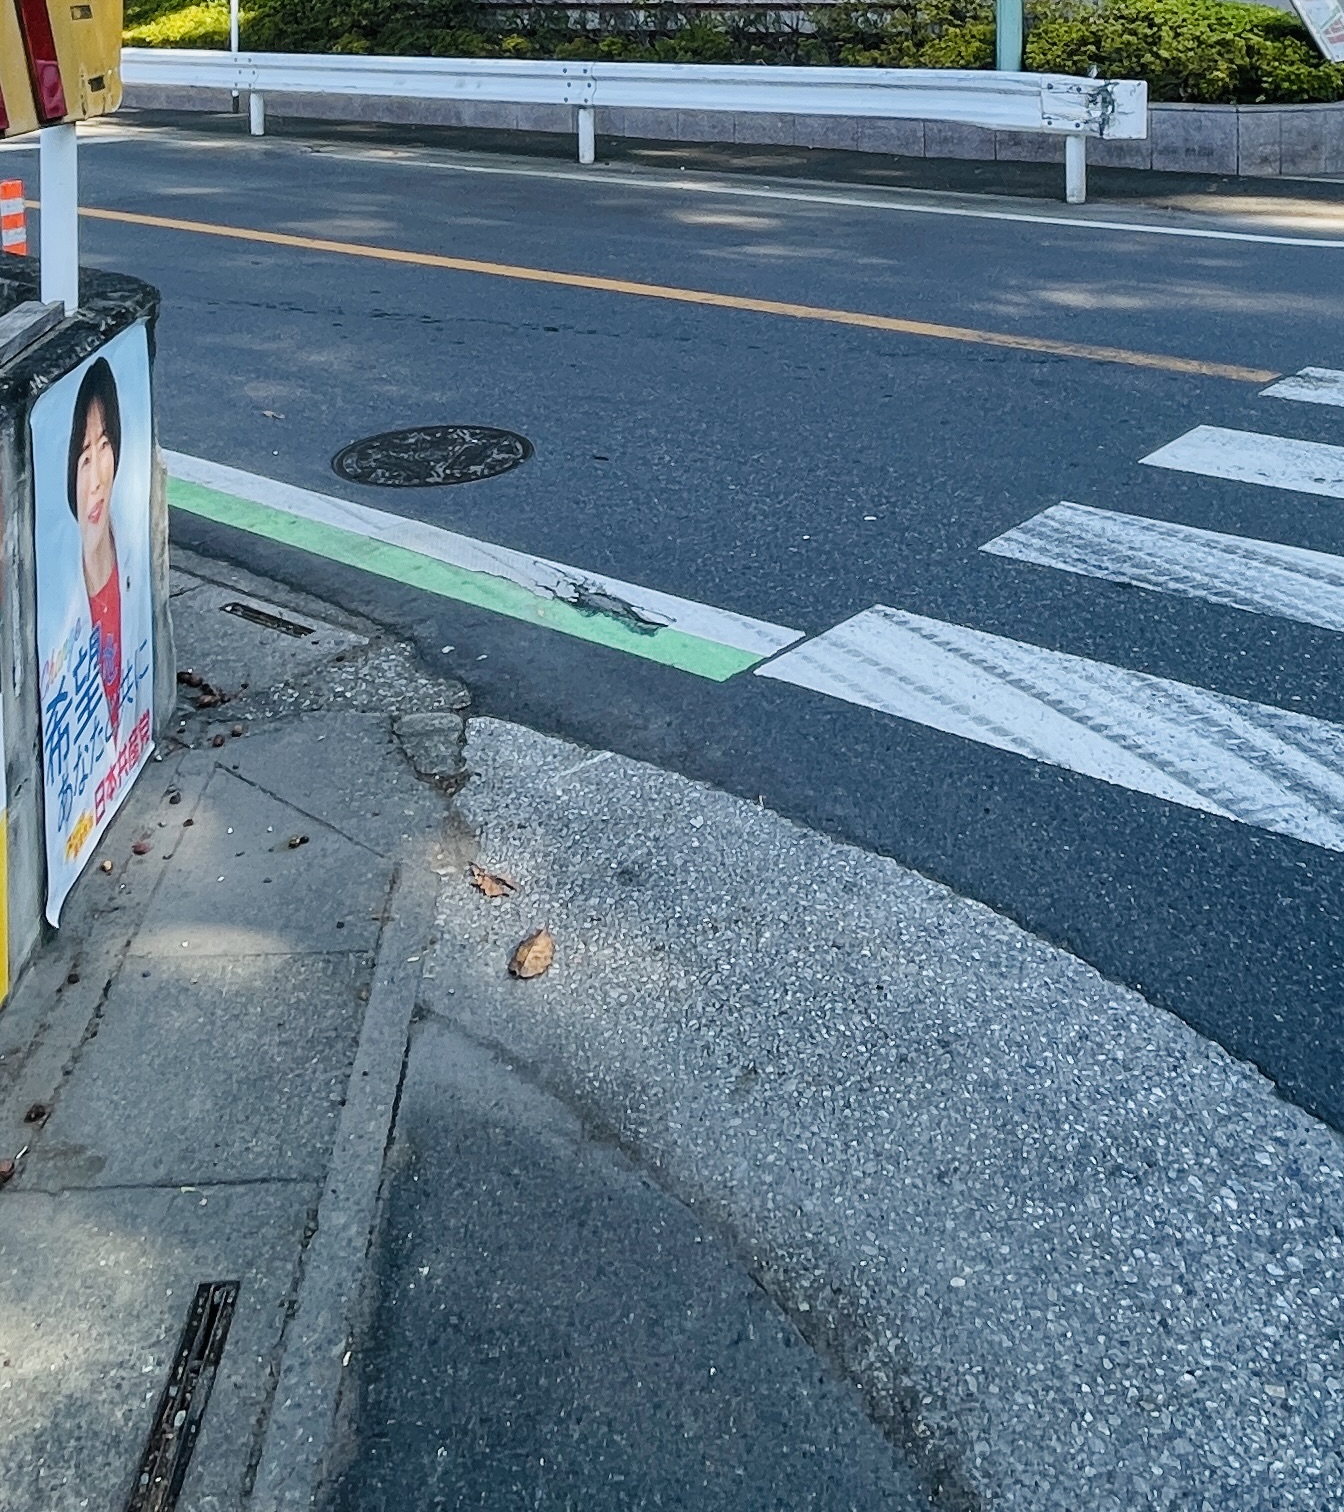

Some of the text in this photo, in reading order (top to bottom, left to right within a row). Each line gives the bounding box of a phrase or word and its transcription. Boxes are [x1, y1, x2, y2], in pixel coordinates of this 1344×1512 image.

[95, 708, 150, 827] 日本共産党
